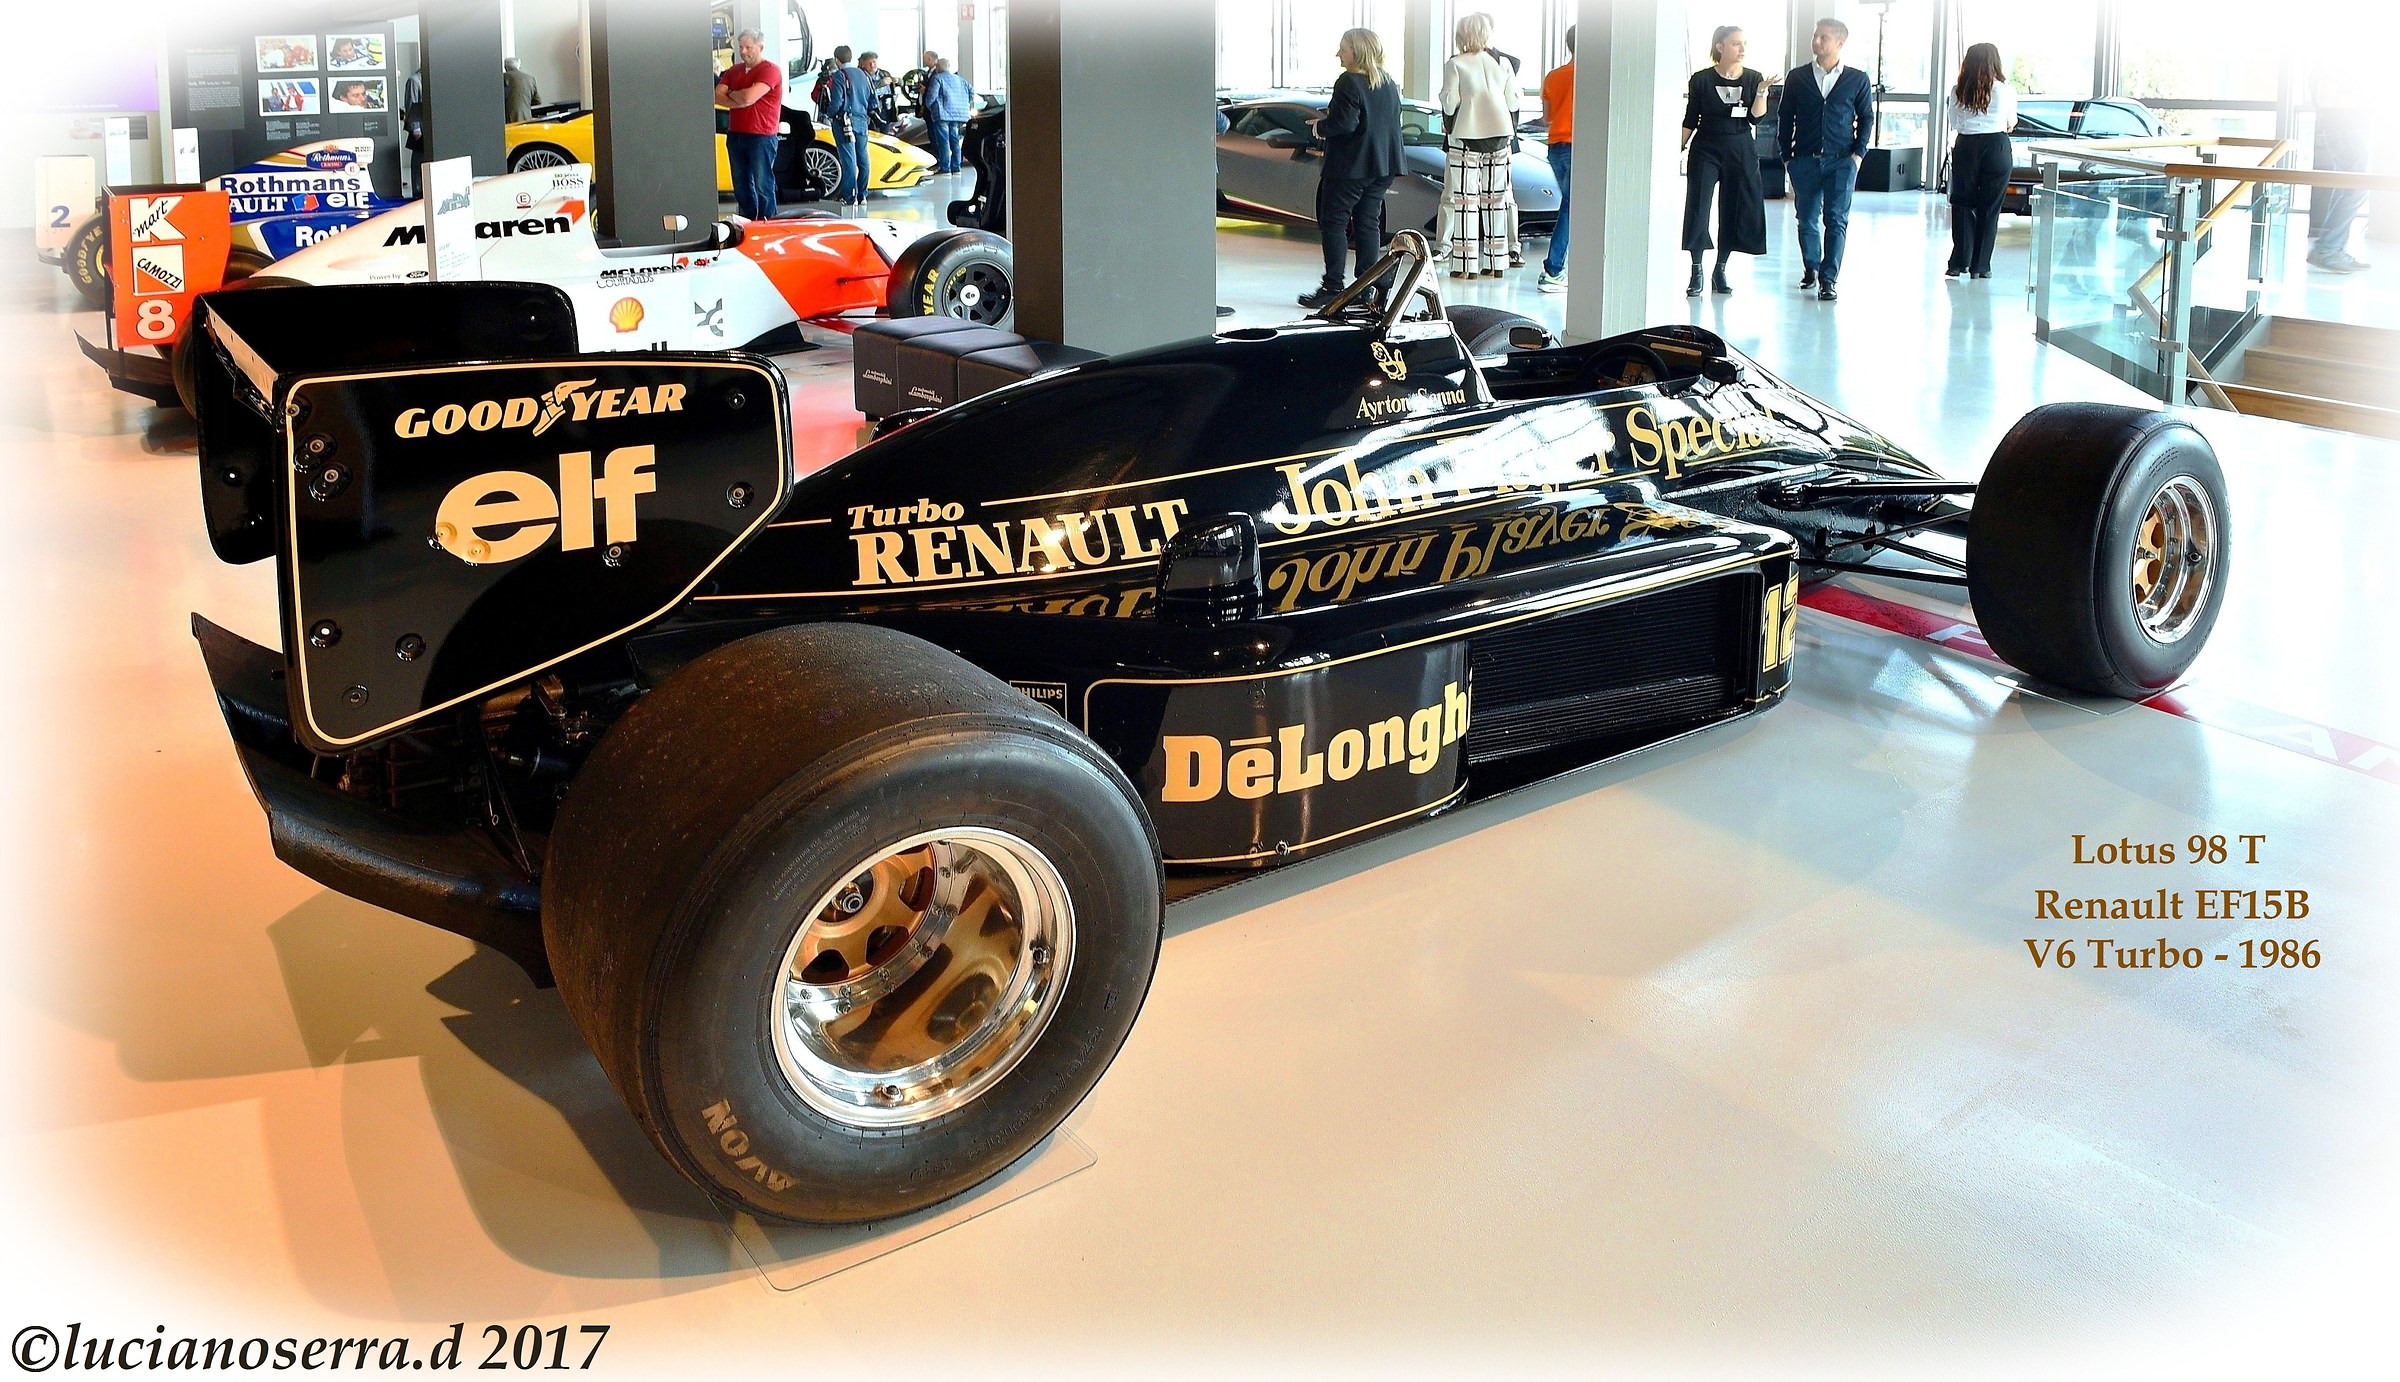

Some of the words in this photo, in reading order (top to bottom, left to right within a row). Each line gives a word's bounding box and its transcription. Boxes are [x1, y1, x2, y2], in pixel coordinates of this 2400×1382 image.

[220, 175, 361, 194] Rothmans
[50, 205, 71, 228] 2
[229, 196, 288, 213] AULT
[383, 216, 570, 247] Maren
[77, 225, 103, 284] GOODYE
[137, 257, 183, 289] CAMOZZI
[922, 268, 939, 315] YEAR
[136, 299, 176, 340] 8
[1356, 395, 1412, 421] Ayrton
[436, 444, 656, 564] elf
[847, 498, 965, 531] Turbo
[849, 498, 1189, 586] RENAULT
[1762, 573, 1798, 673] 12
[701, 1098, 797, 1193] AVON
